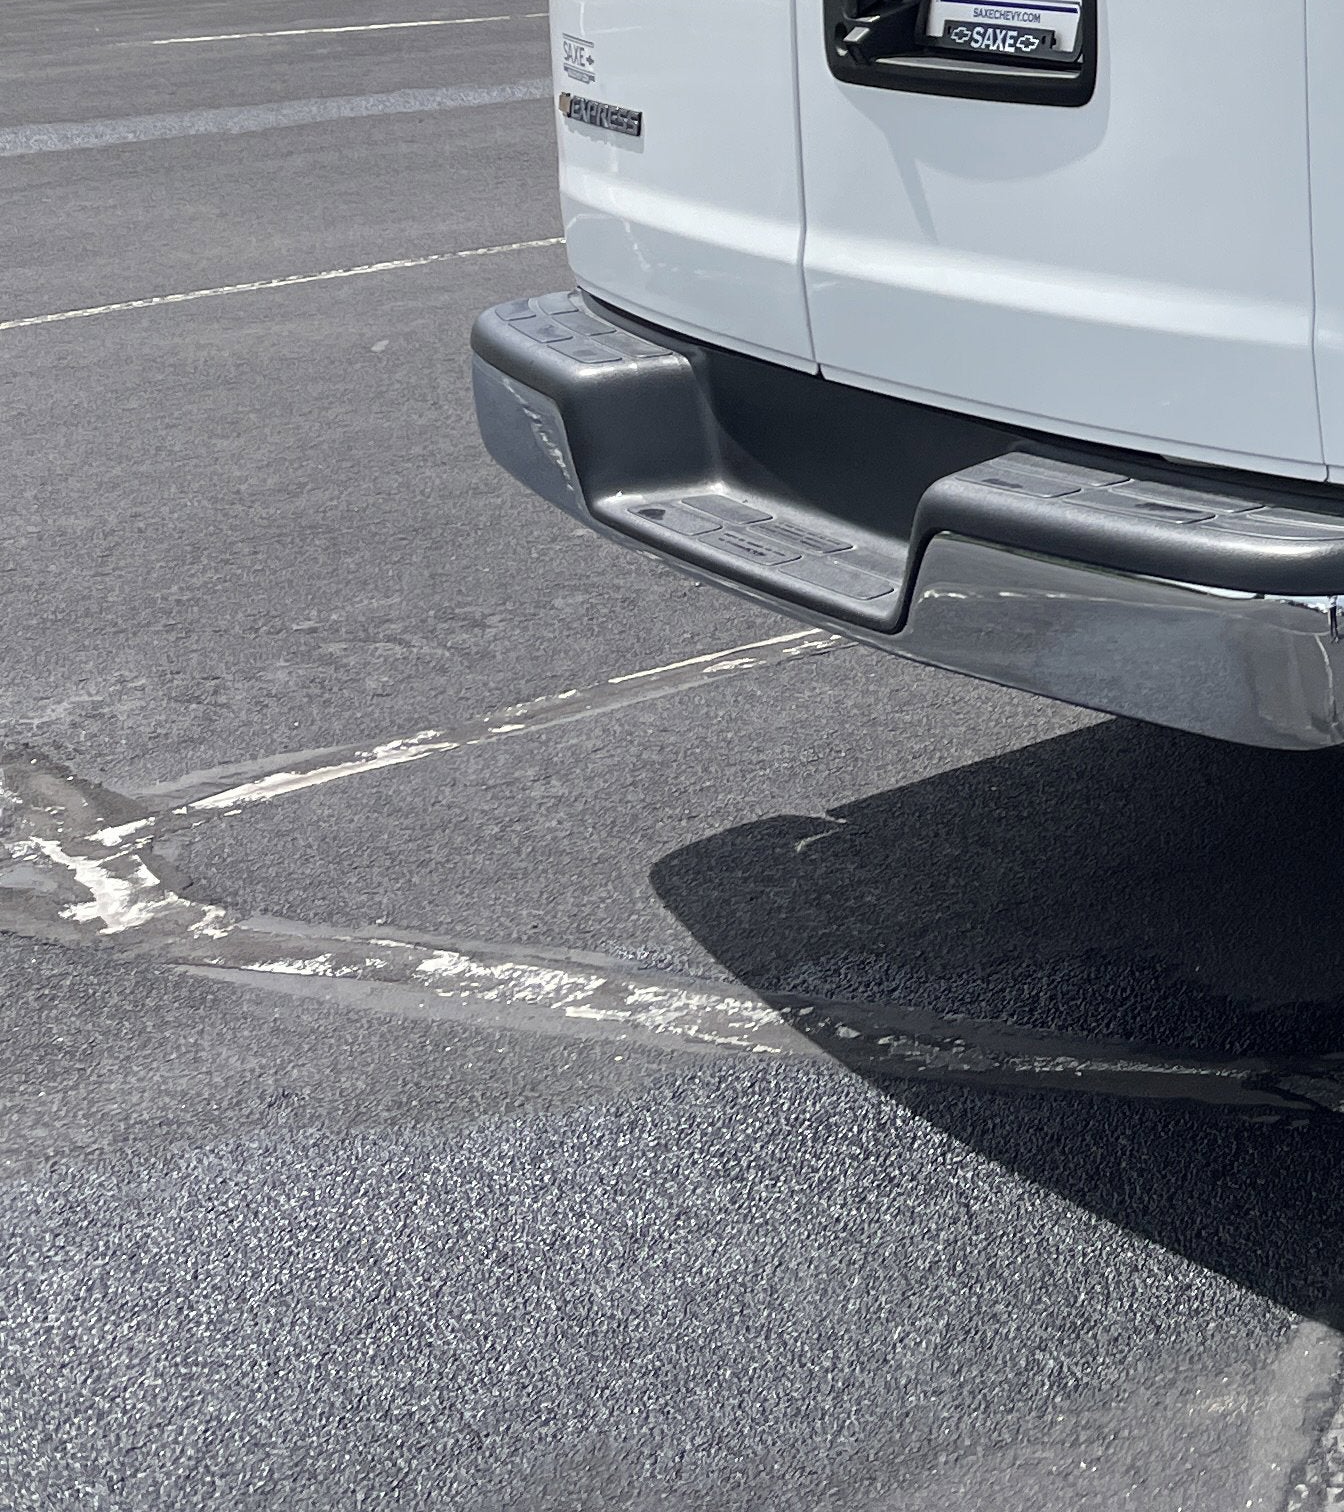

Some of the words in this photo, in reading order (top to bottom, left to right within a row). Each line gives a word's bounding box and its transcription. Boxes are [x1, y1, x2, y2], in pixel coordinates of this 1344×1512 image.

[973, 8, 1041, 23] SAXECHEVY.COM
[970, 26, 1018, 53] SAXE
[563, 40, 586, 67] SAXE
[571, 97, 641, 135] EXPRESS
